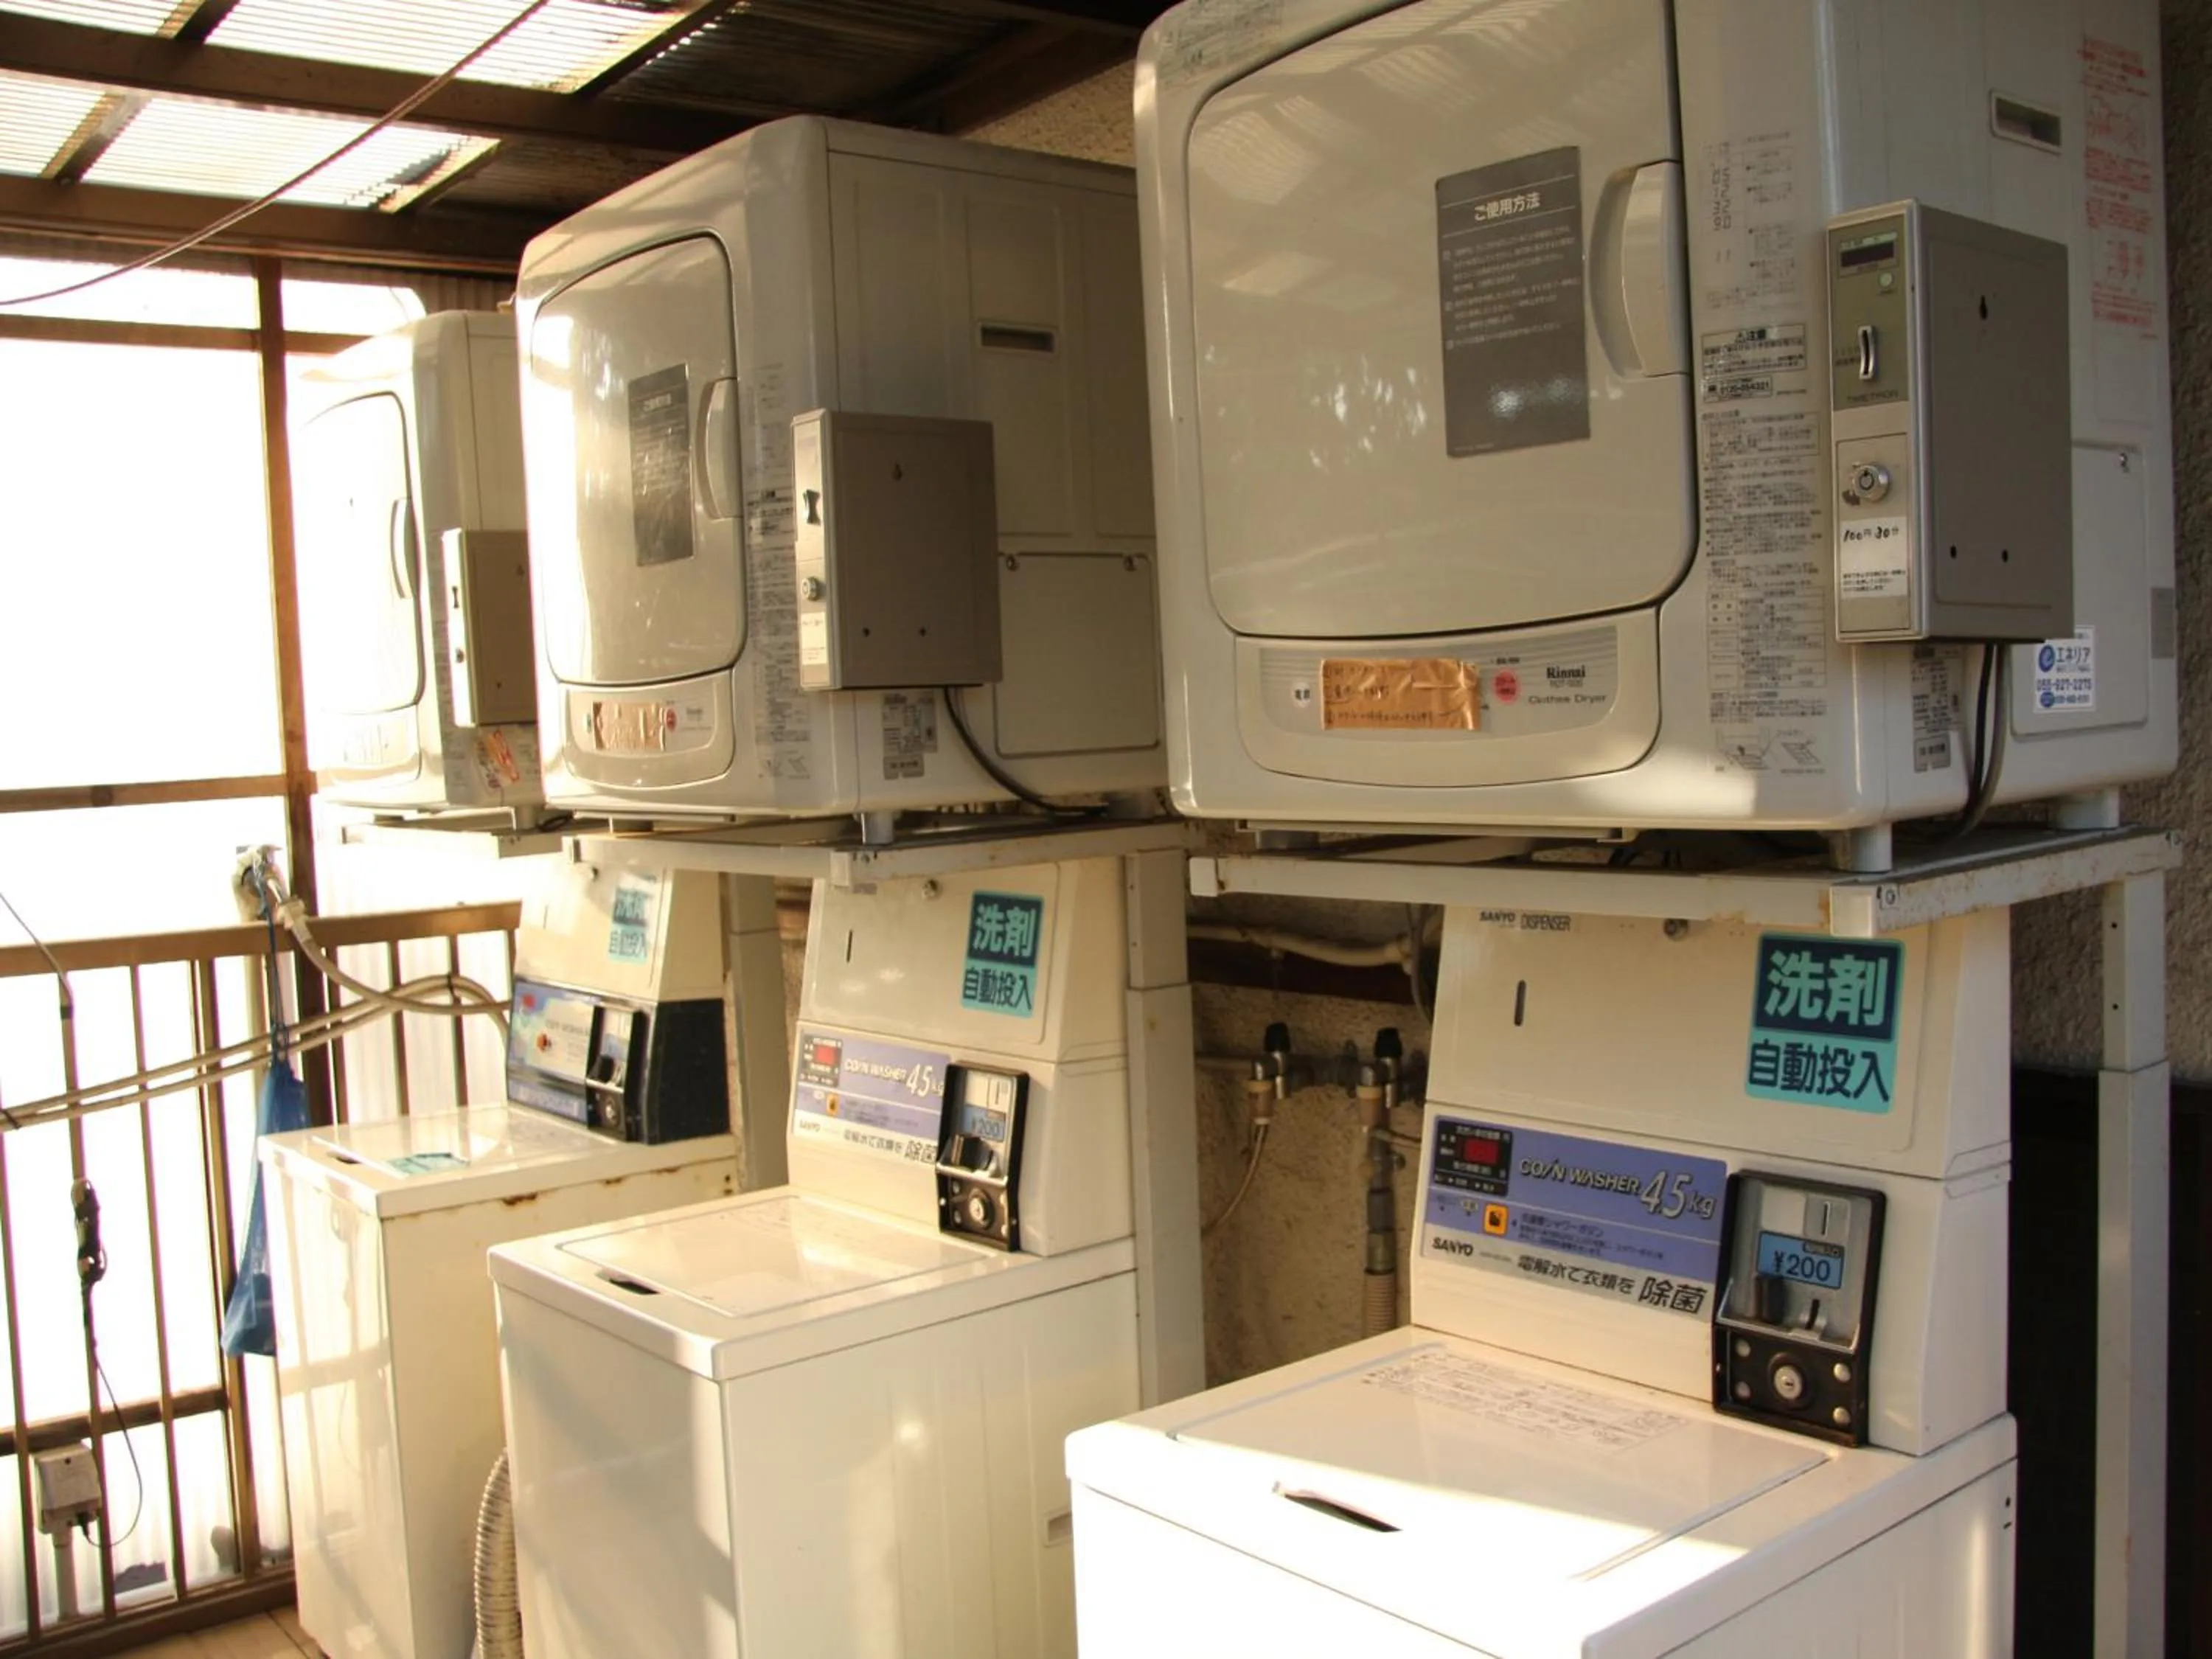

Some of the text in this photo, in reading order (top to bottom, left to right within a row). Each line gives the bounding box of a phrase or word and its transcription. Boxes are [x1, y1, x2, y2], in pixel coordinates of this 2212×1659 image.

[1475, 192, 1541, 221] ご使用方法
[1546, 664, 1586, 678] Rinnai
[1529, 694, 1607, 704] Clothes Dryer
[973, 902, 1036, 958] 洗剤
[1479, 911, 1516, 922] SANYO
[962, 967, 1032, 1012] 自動投入
[1764, 950, 1889, 1026] 洗剤
[1749, 1038, 1890, 1102] 自動投入
[1520, 1158, 1567, 1181] COIN
[1568, 1166, 1641, 1195] WASHER
[1432, 1237, 1474, 1257] SANYO
[1773, 1250, 1831, 1281] ¥200
[1517, 1254, 1708, 1315] 電解水で衣類を 除菌
